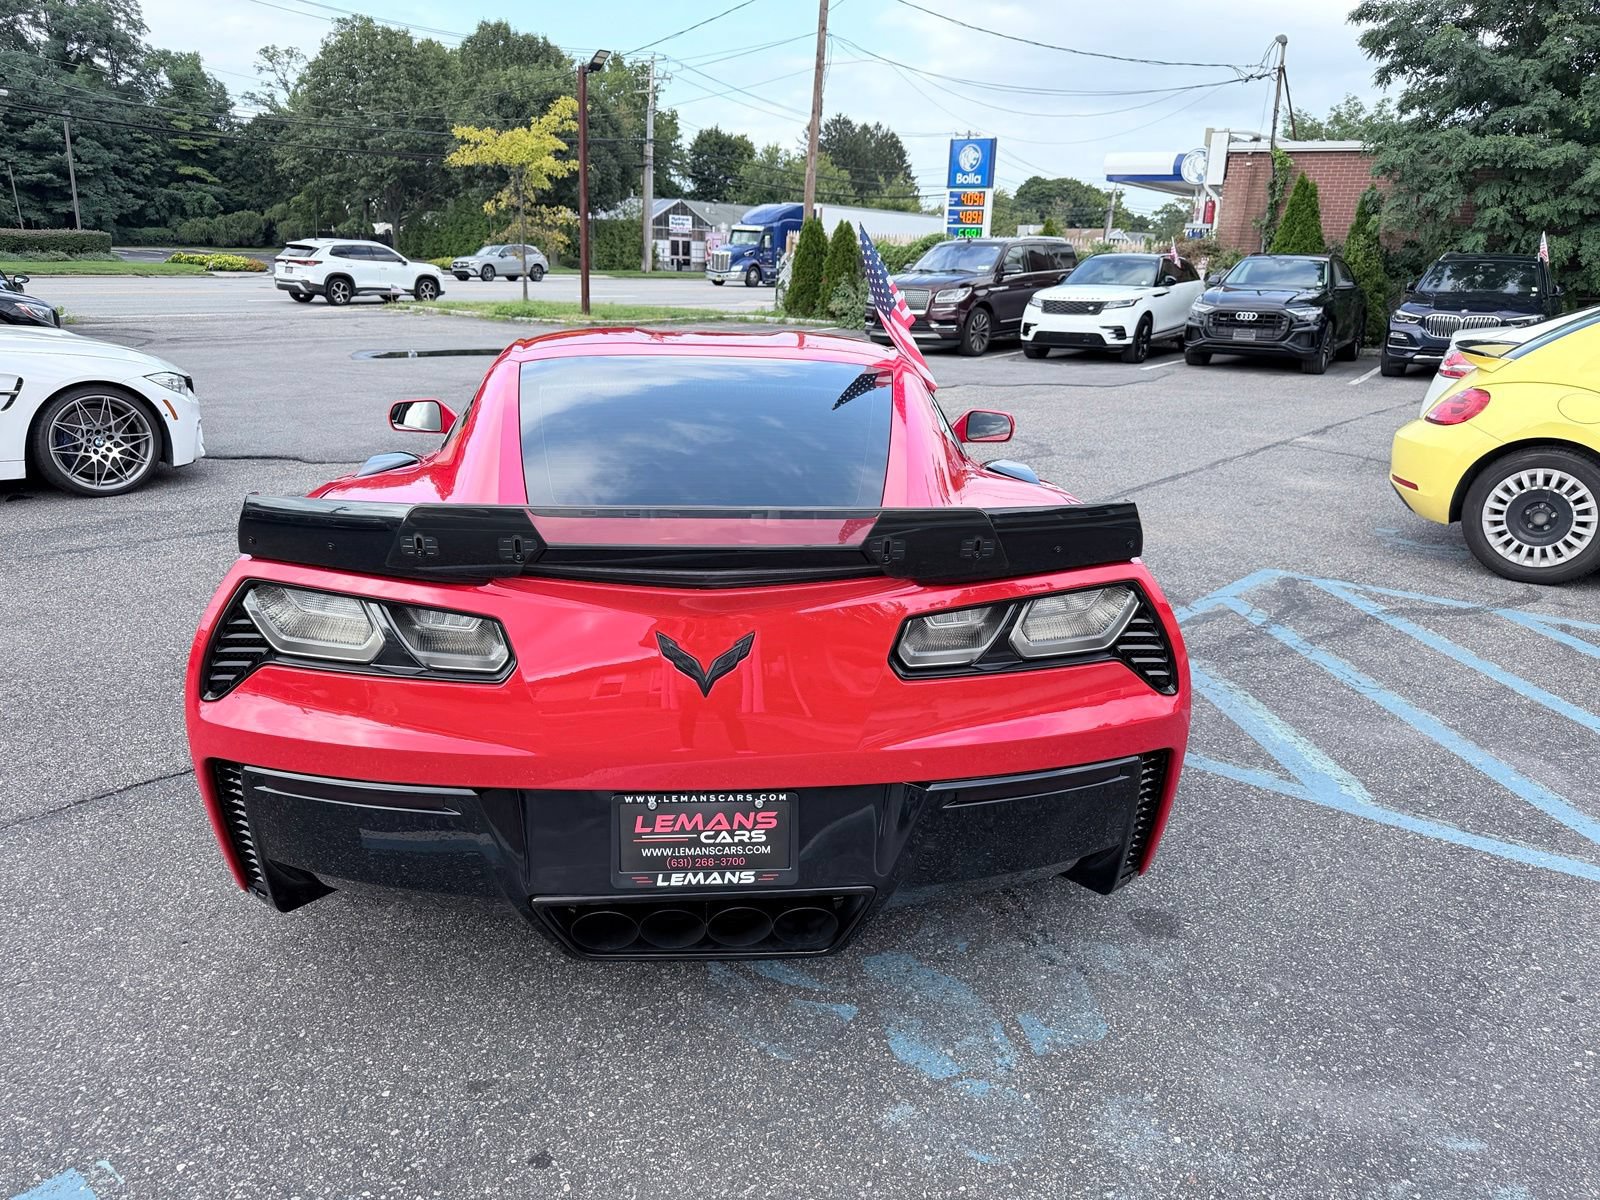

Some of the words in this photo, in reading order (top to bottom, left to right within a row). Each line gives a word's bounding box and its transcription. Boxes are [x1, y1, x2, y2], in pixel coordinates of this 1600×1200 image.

[956, 173, 981, 184] Bolla
[624, 794, 787, 803] WWW.LEMANSCARS.COM
[634, 812, 778, 833] LEMANS
[700, 830, 767, 843] CARS
[641, 845, 771, 857] WWW.LEMANSCARS.COM
[666, 857, 692, 869] (631)
[695, 857, 746, 867] 268-3700
[656, 871, 756, 886] LEMANS
